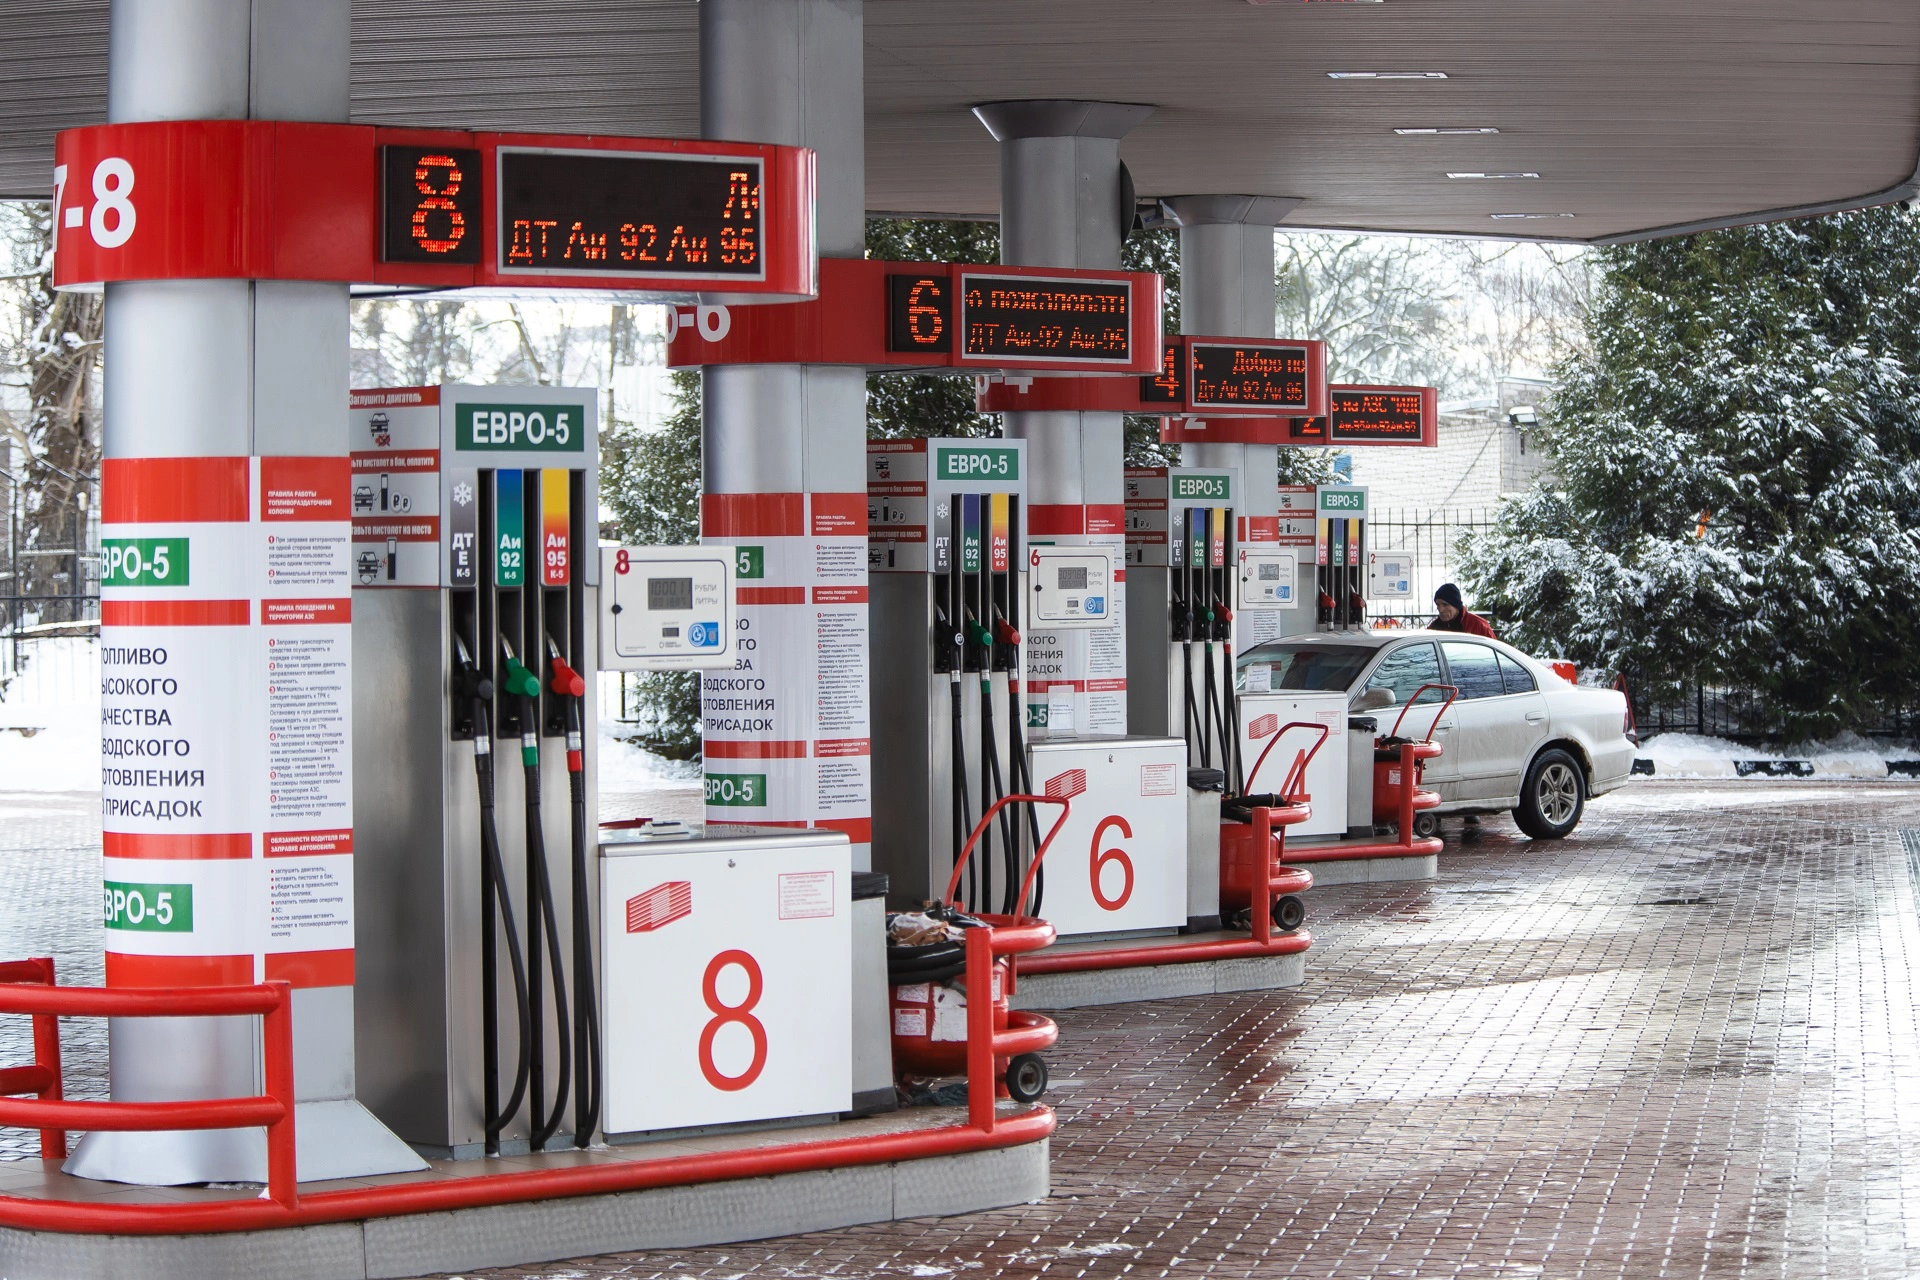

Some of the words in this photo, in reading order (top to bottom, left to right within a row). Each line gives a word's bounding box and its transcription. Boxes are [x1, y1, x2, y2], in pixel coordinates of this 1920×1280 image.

[412, 153, 465, 254] 8
[508, 219, 558, 264] ДТ
[621, 223, 657, 261] 92
[720, 227, 757, 264] 95
[907, 279, 944, 344] 6
[1154, 348, 1179, 397] 4
[1243, 381, 1260, 400] 92
[1286, 382, 1303, 400] 95
[350, 394, 385, 406] Заглушите
[386, 392, 422, 404] двигатель
[472, 411, 570, 445] ЕВРО-5
[363, 458, 389, 467] пистолет
[407, 456, 434, 466] оплатите
[948, 454, 1008, 475] ЕВРО-5
[1179, 479, 1223, 495] ЕВРО-5
[1326, 494, 1359, 507] ЕВРО-5
[372, 526, 402, 535] пистолет
[403, 526, 411, 535] на
[411, 525, 432, 535] место
[452, 532, 474, 551] ДТ
[500, 533, 521, 549] Аи
[546, 532, 566, 548] Аи
[935, 537, 949, 550] ДТ
[965, 538, 978, 547] Аи
[993, 538, 1006, 547] Аи
[1173, 540, 1183, 549] ДТ
[459, 551, 468, 565] Е
[501, 552, 521, 567] 92
[546, 551, 567, 567] 95
[939, 549, 946, 559] Е
[965, 549, 979, 559] 92
[993, 549, 1007, 559] 95
[1030, 549, 1041, 567] 6
[1194, 549, 1204, 557] 92
[1214, 549, 1224, 557] 95
[1239, 550, 1247, 561] 4
[1370, 553, 1376, 564] 2
[101, 545, 170, 579] ВРО-5
[615, 549, 630, 575] 8
[694, 584, 717, 592] РУБЛИ
[102, 708, 172, 726] АЧЕСТВА
[1279, 748, 1311, 802] 4
[703, 779, 754, 802] ВРО-5
[106, 799, 202, 821] ПРИСАДОК
[1090, 815, 1134, 911] 6
[103, 889, 174, 925] ВРО-5
[698, 949, 768, 1091] 8
